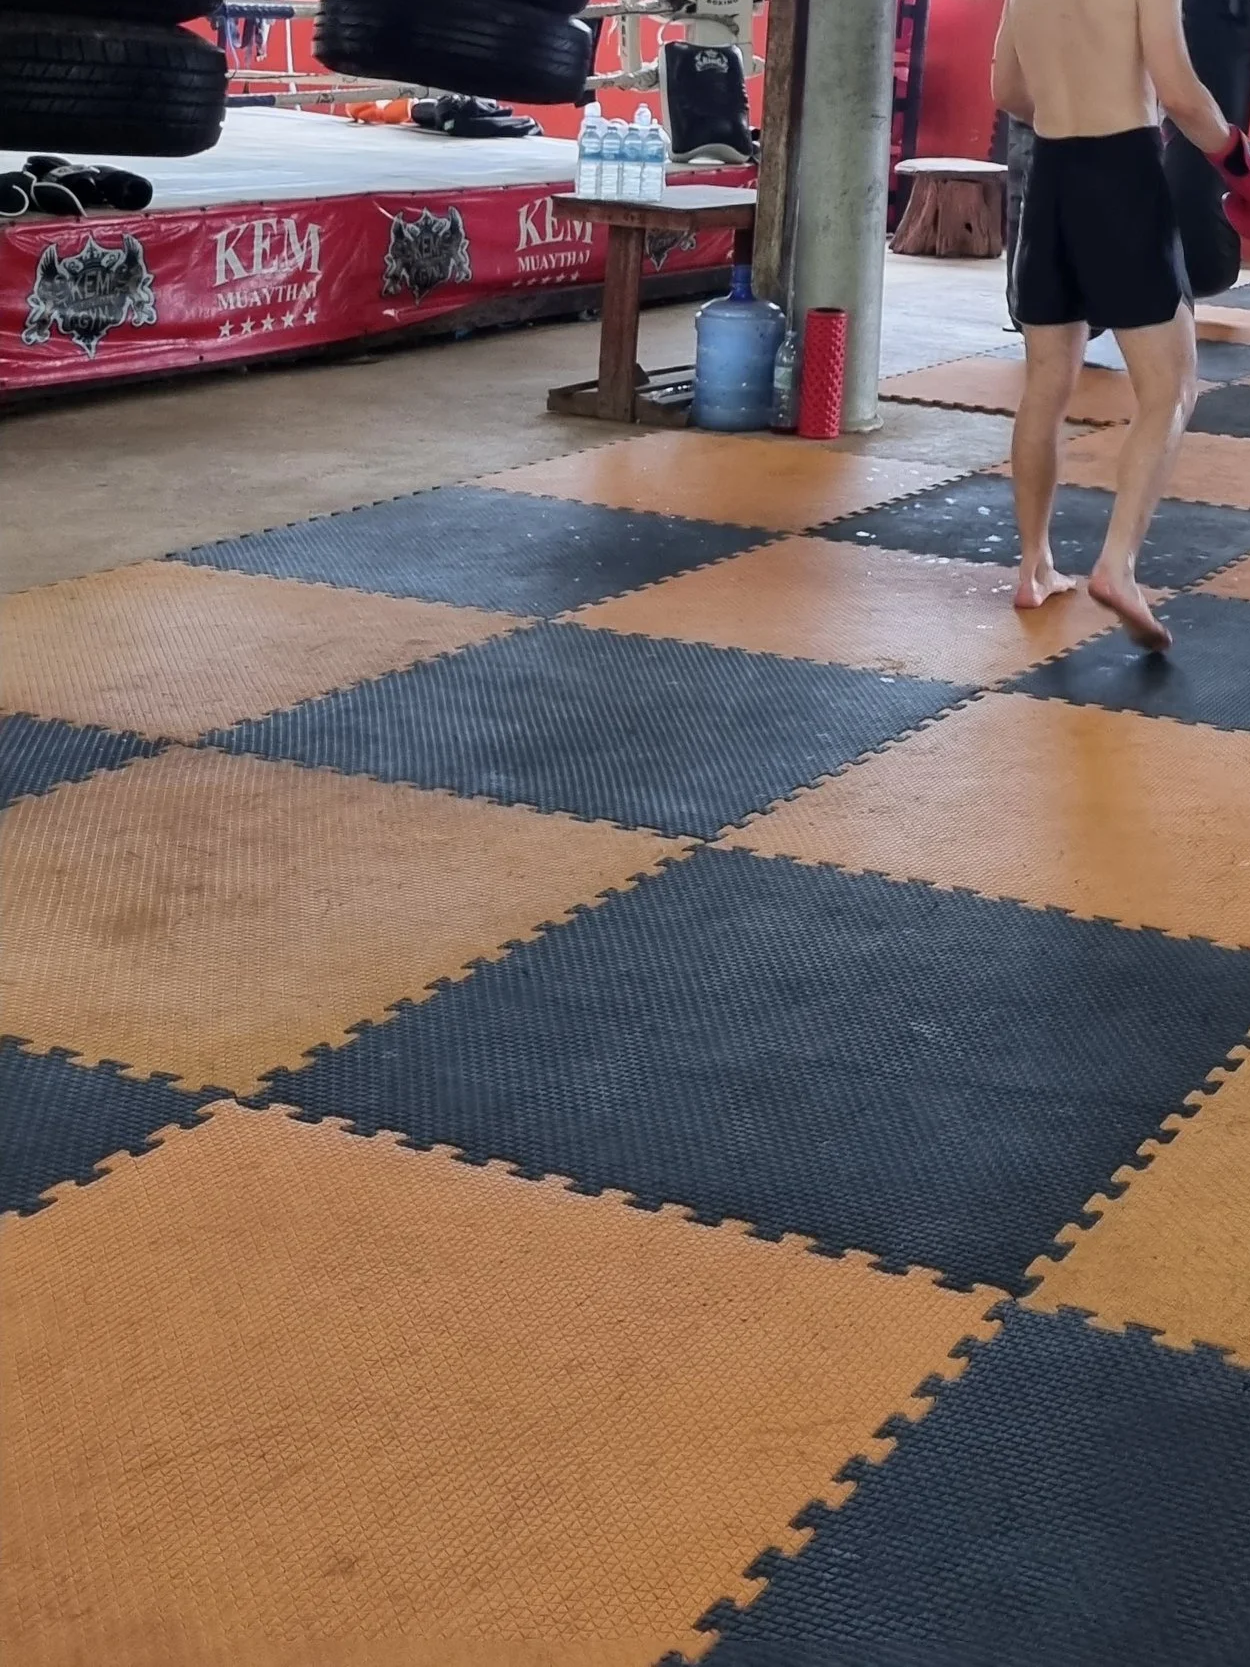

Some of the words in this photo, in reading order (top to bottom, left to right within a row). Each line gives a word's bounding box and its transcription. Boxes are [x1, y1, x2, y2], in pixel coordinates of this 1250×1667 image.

[212, 218, 322, 288] KEM
[517, 250, 590, 273] MUAYTHAI
[69, 271, 110, 300] KEM
